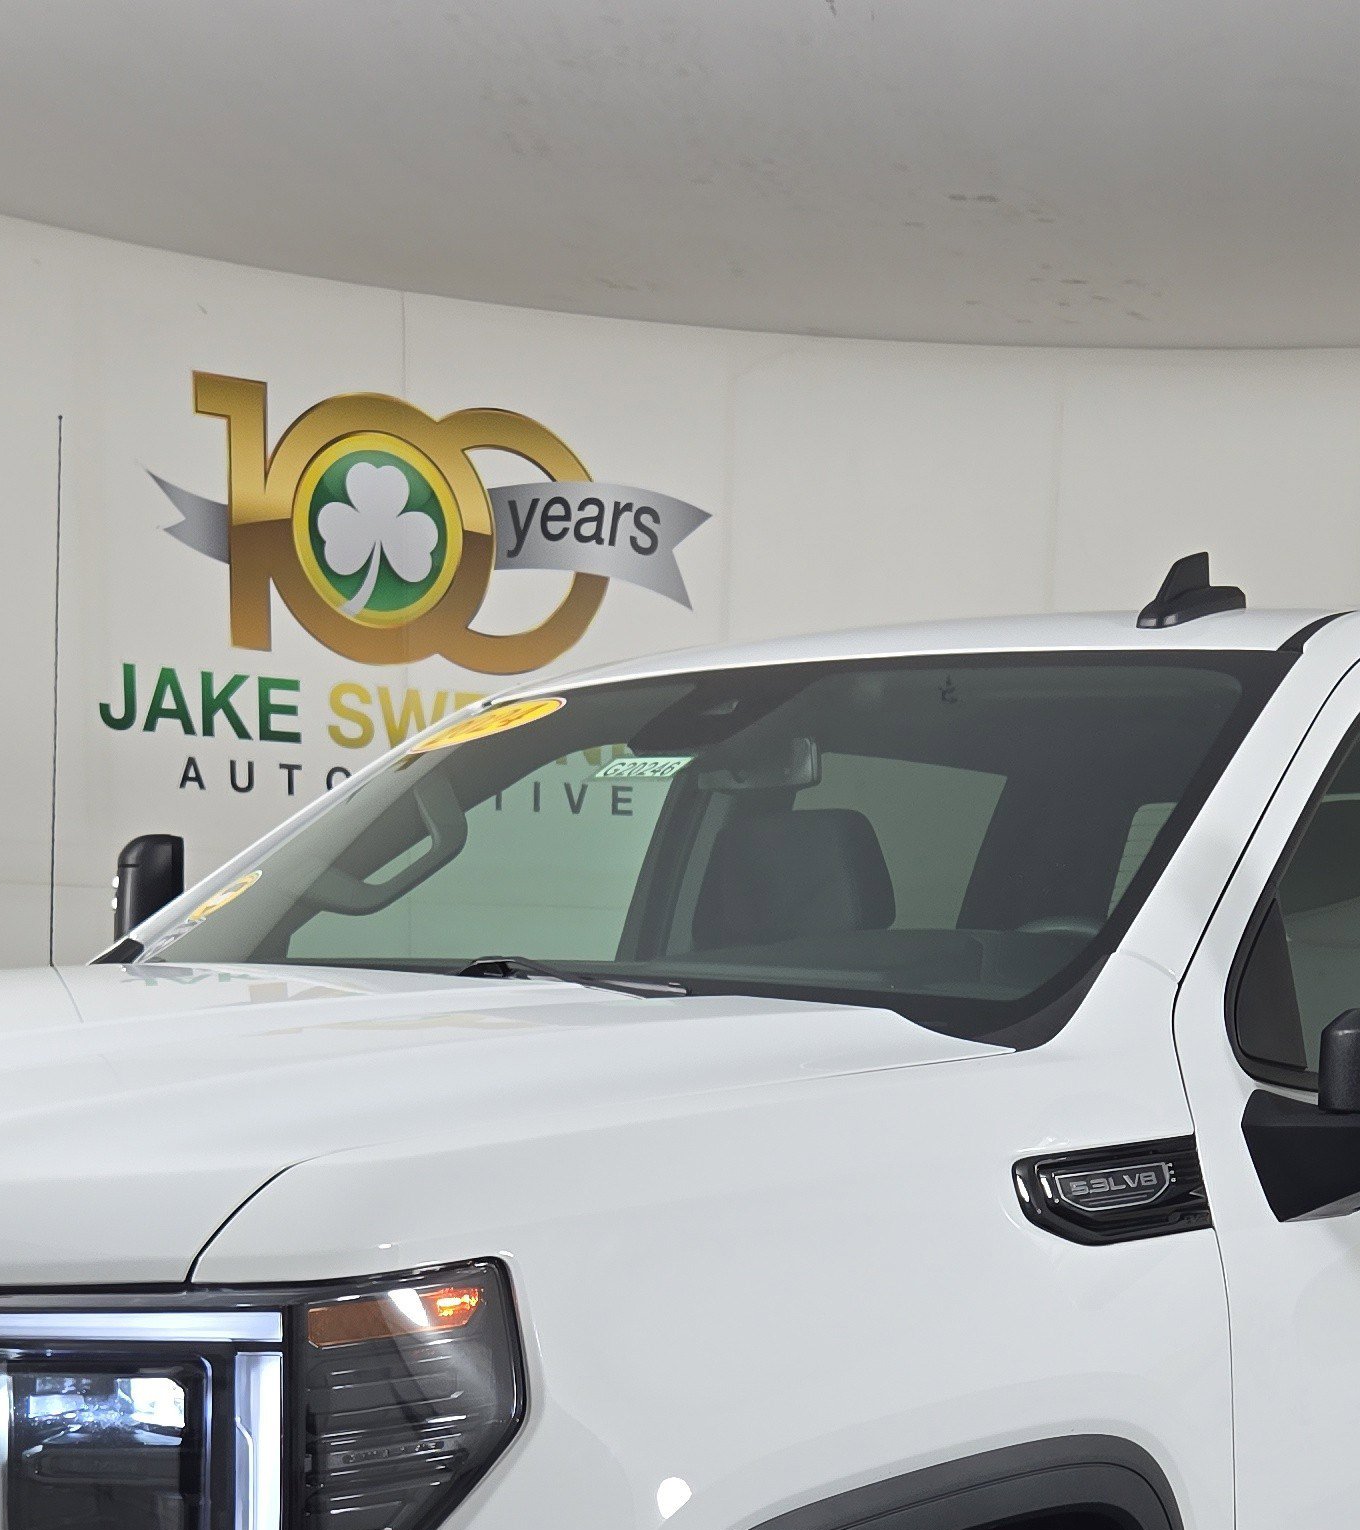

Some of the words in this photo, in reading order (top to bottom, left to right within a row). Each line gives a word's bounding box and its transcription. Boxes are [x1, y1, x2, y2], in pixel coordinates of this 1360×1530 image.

[506, 494, 661, 559] years
[99, 662, 303, 744] JAKE
[602, 760, 682, 777] G20246
